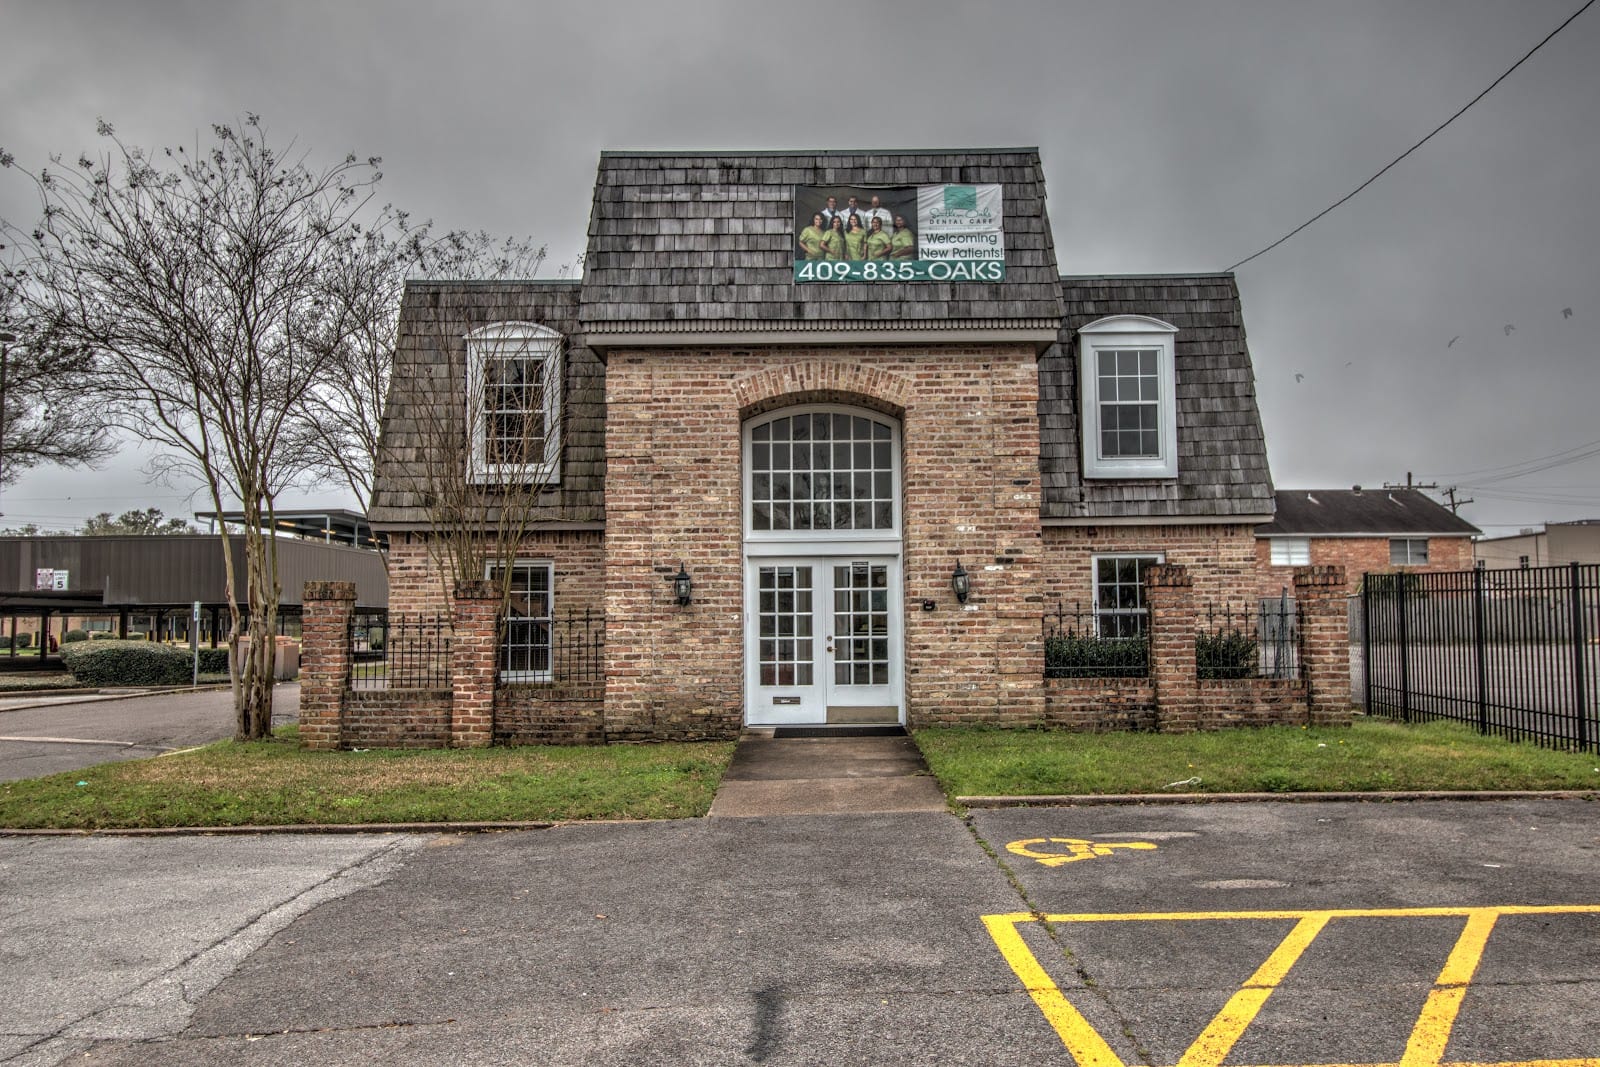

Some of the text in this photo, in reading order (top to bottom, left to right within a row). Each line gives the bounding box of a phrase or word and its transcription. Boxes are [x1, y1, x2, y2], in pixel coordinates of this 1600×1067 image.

[929, 207, 991, 219] Southern Oaks
[926, 233, 998, 245] Welcoming
[920, 247, 1004, 258] New Patients!
[798, 262, 1002, 280] 409-835-OAKS
